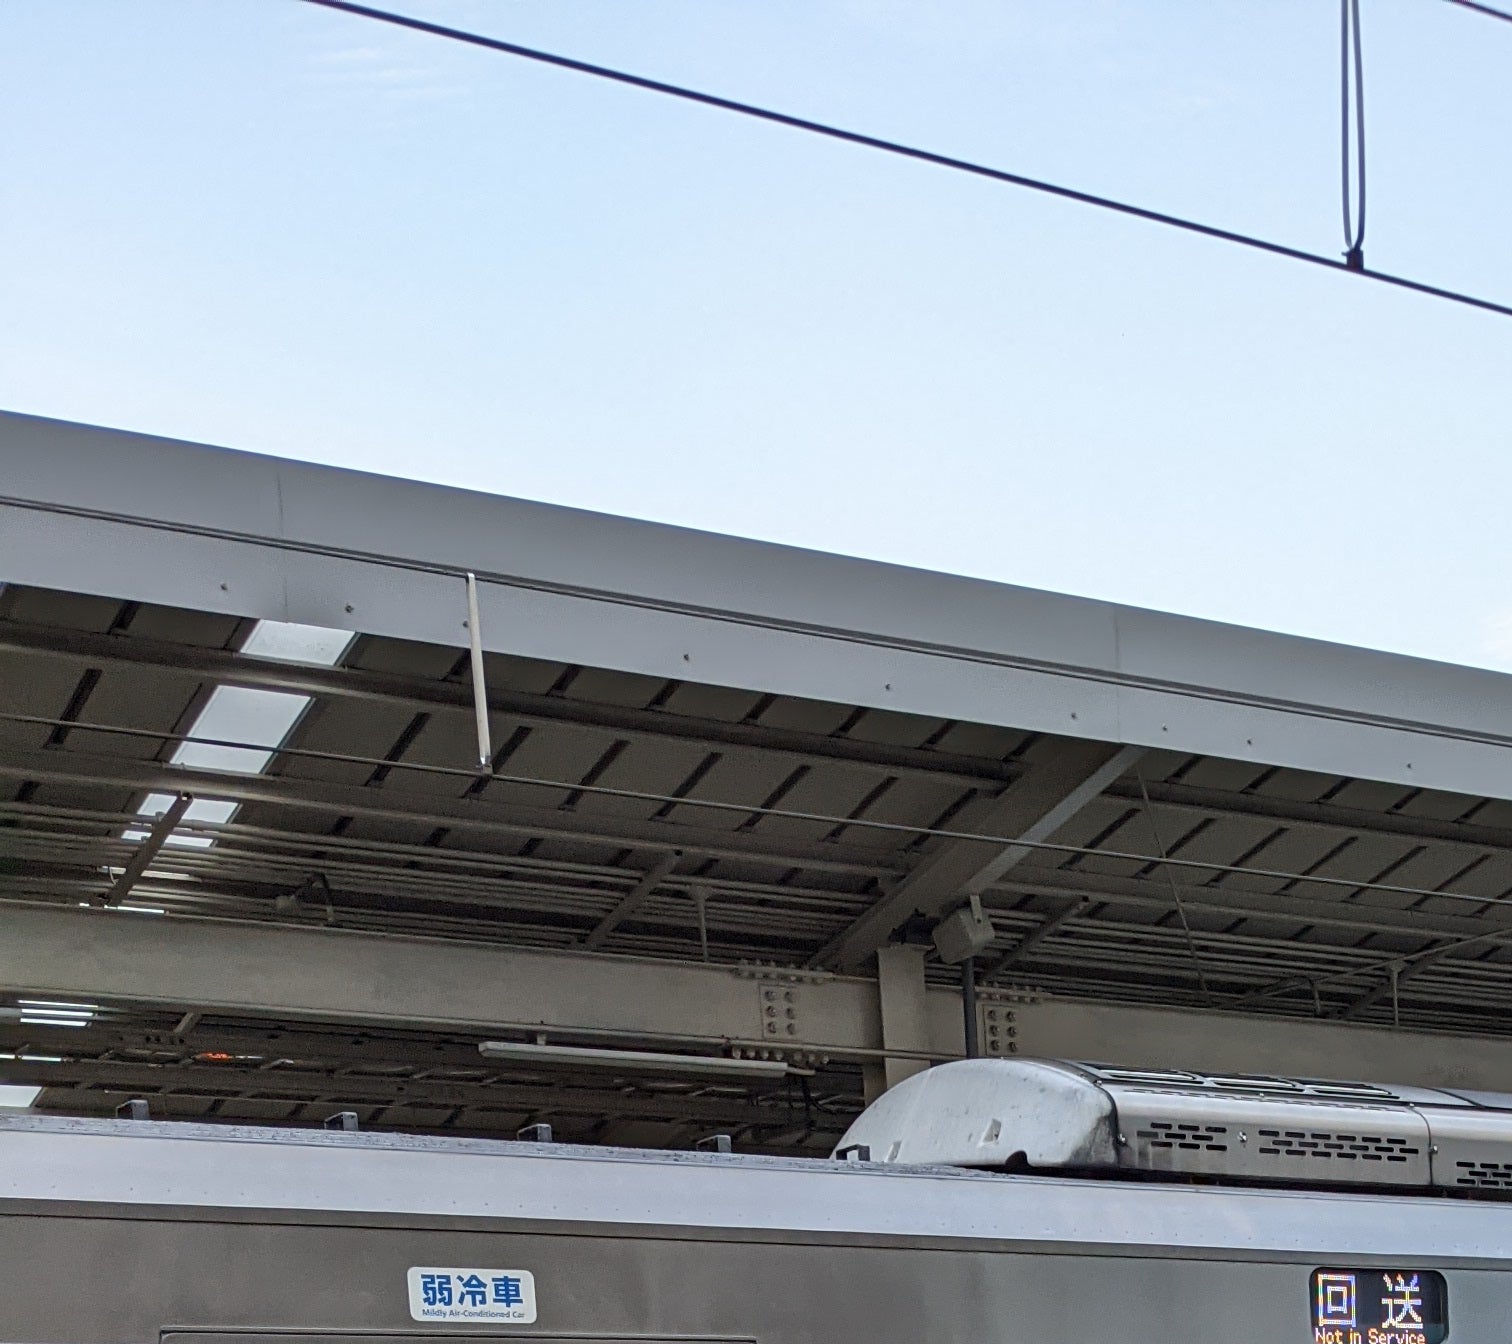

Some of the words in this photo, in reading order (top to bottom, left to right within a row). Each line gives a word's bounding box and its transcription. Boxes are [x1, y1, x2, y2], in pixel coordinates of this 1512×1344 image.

[421, 1274, 523, 1307] 弱冷車
[1318, 1273, 1424, 1328] 回送
[422, 1308, 447, 1319] Mildly
[448, 1309, 511, 1319] Air-Conditioned
[512, 1310, 525, 1319] Car
[1315, 1328, 1343, 1344] Not
